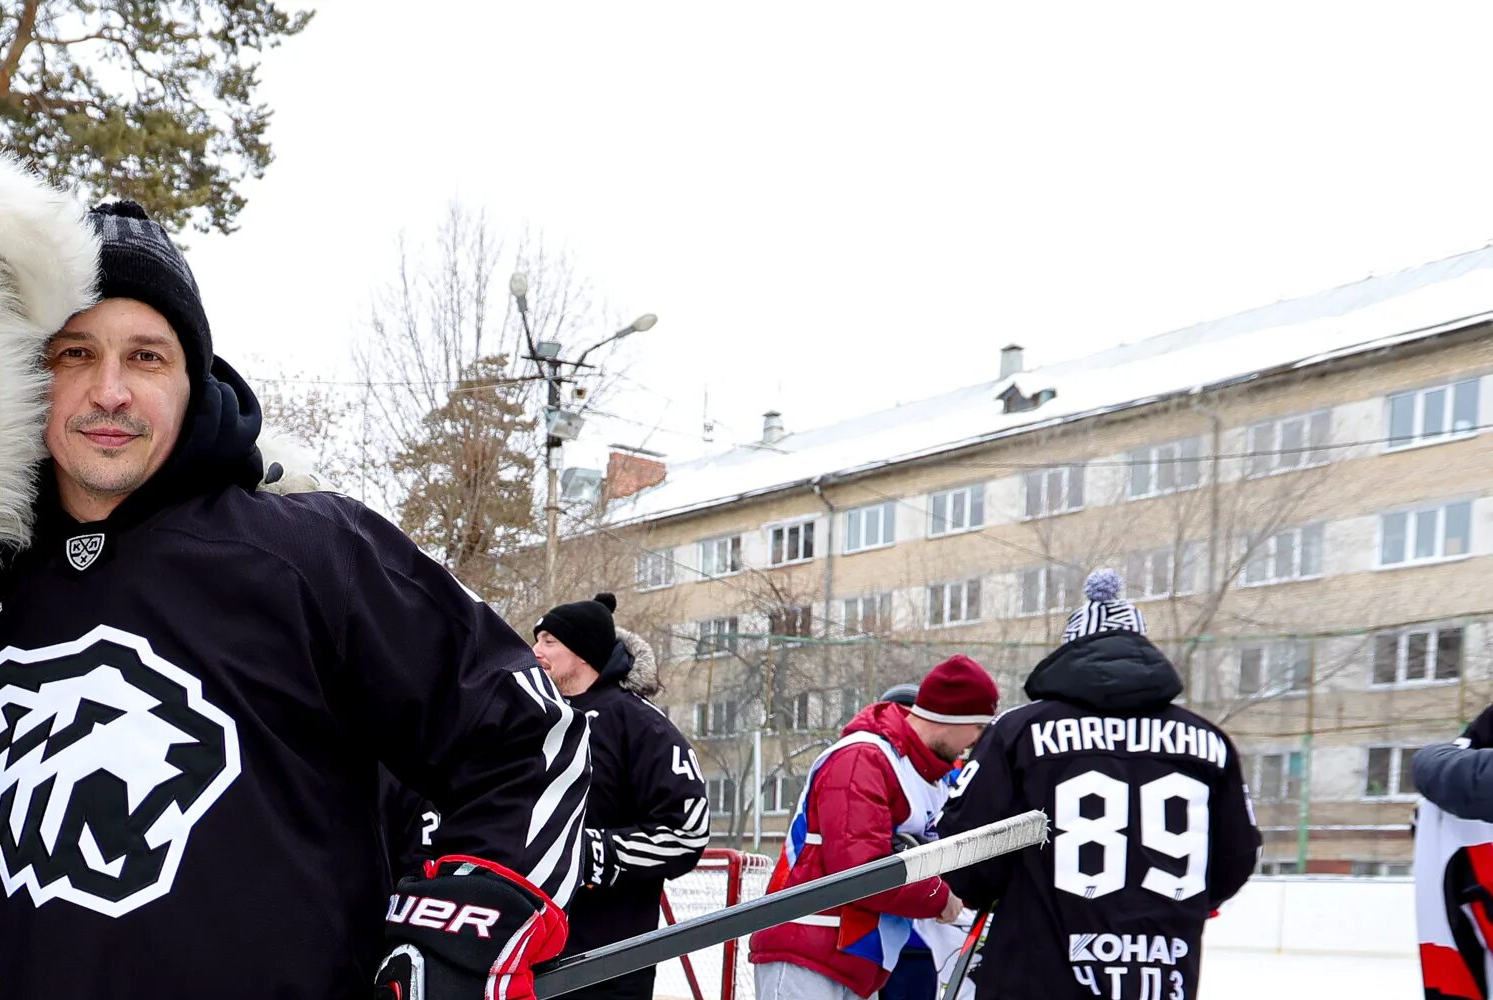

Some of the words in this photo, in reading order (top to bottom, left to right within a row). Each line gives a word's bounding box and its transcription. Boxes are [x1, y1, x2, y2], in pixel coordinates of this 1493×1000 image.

[1031, 716, 1228, 769] KARPUKHIN
[1054, 769, 1210, 901] 89
[1069, 933, 1189, 965] КОНАР
